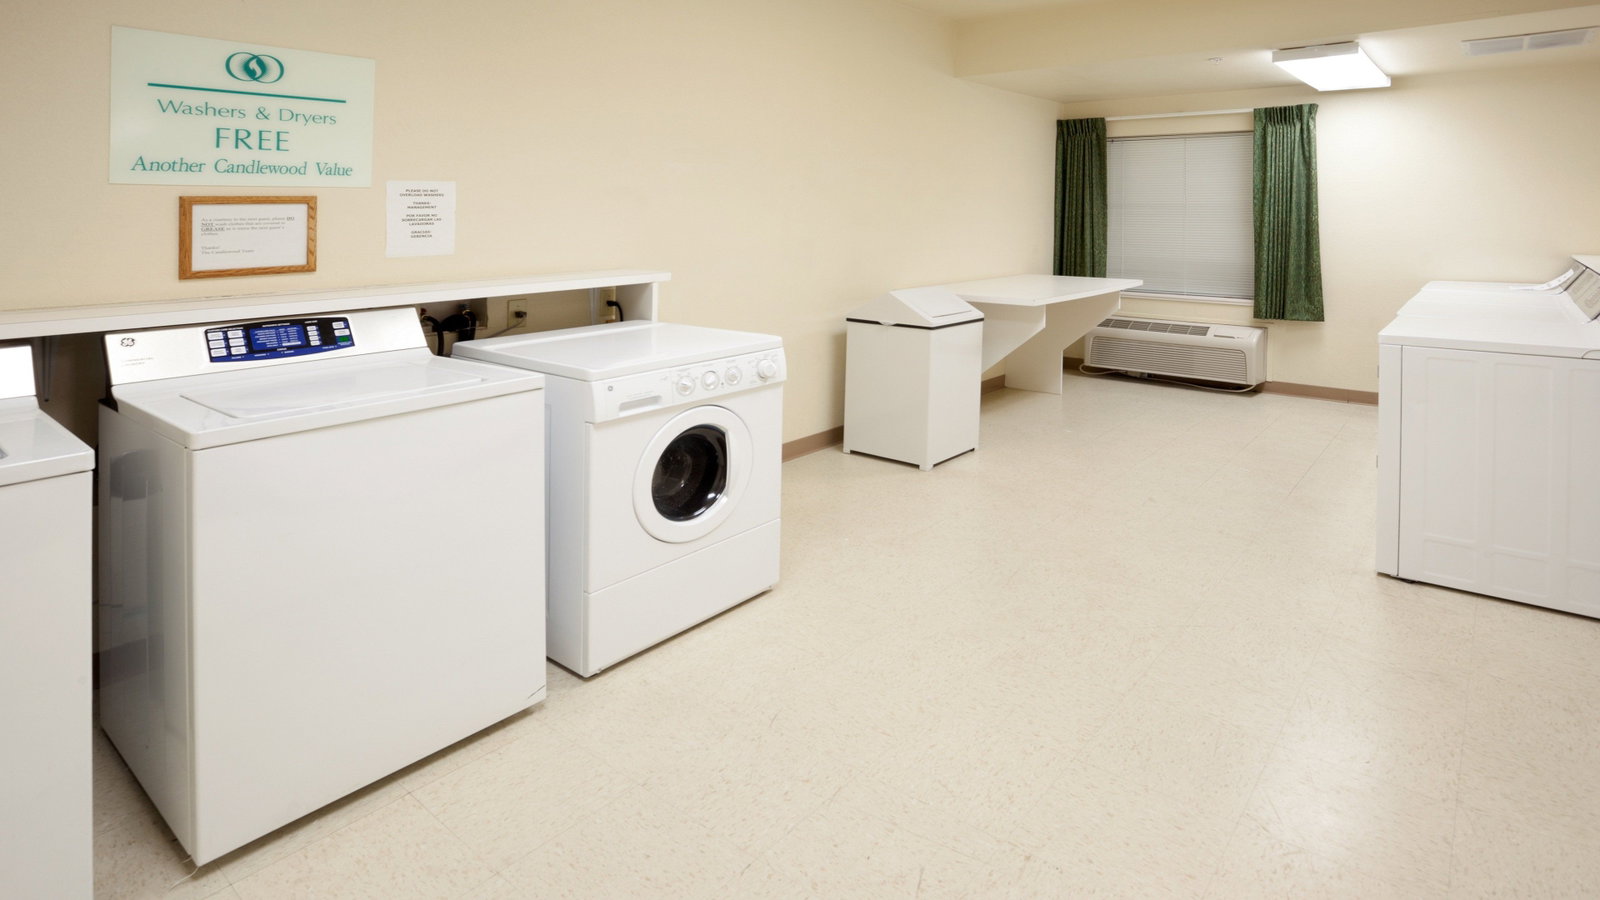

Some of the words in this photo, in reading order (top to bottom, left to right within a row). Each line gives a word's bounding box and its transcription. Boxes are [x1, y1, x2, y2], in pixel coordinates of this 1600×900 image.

[157, 98, 247, 118] Washers
[255, 106, 271, 121] &
[279, 107, 337, 126] Dryers
[215, 127, 290, 152] FREE
[131, 155, 206, 173] Another
[214, 158, 308, 176] Candlewood
[316, 162, 353, 177] Value
